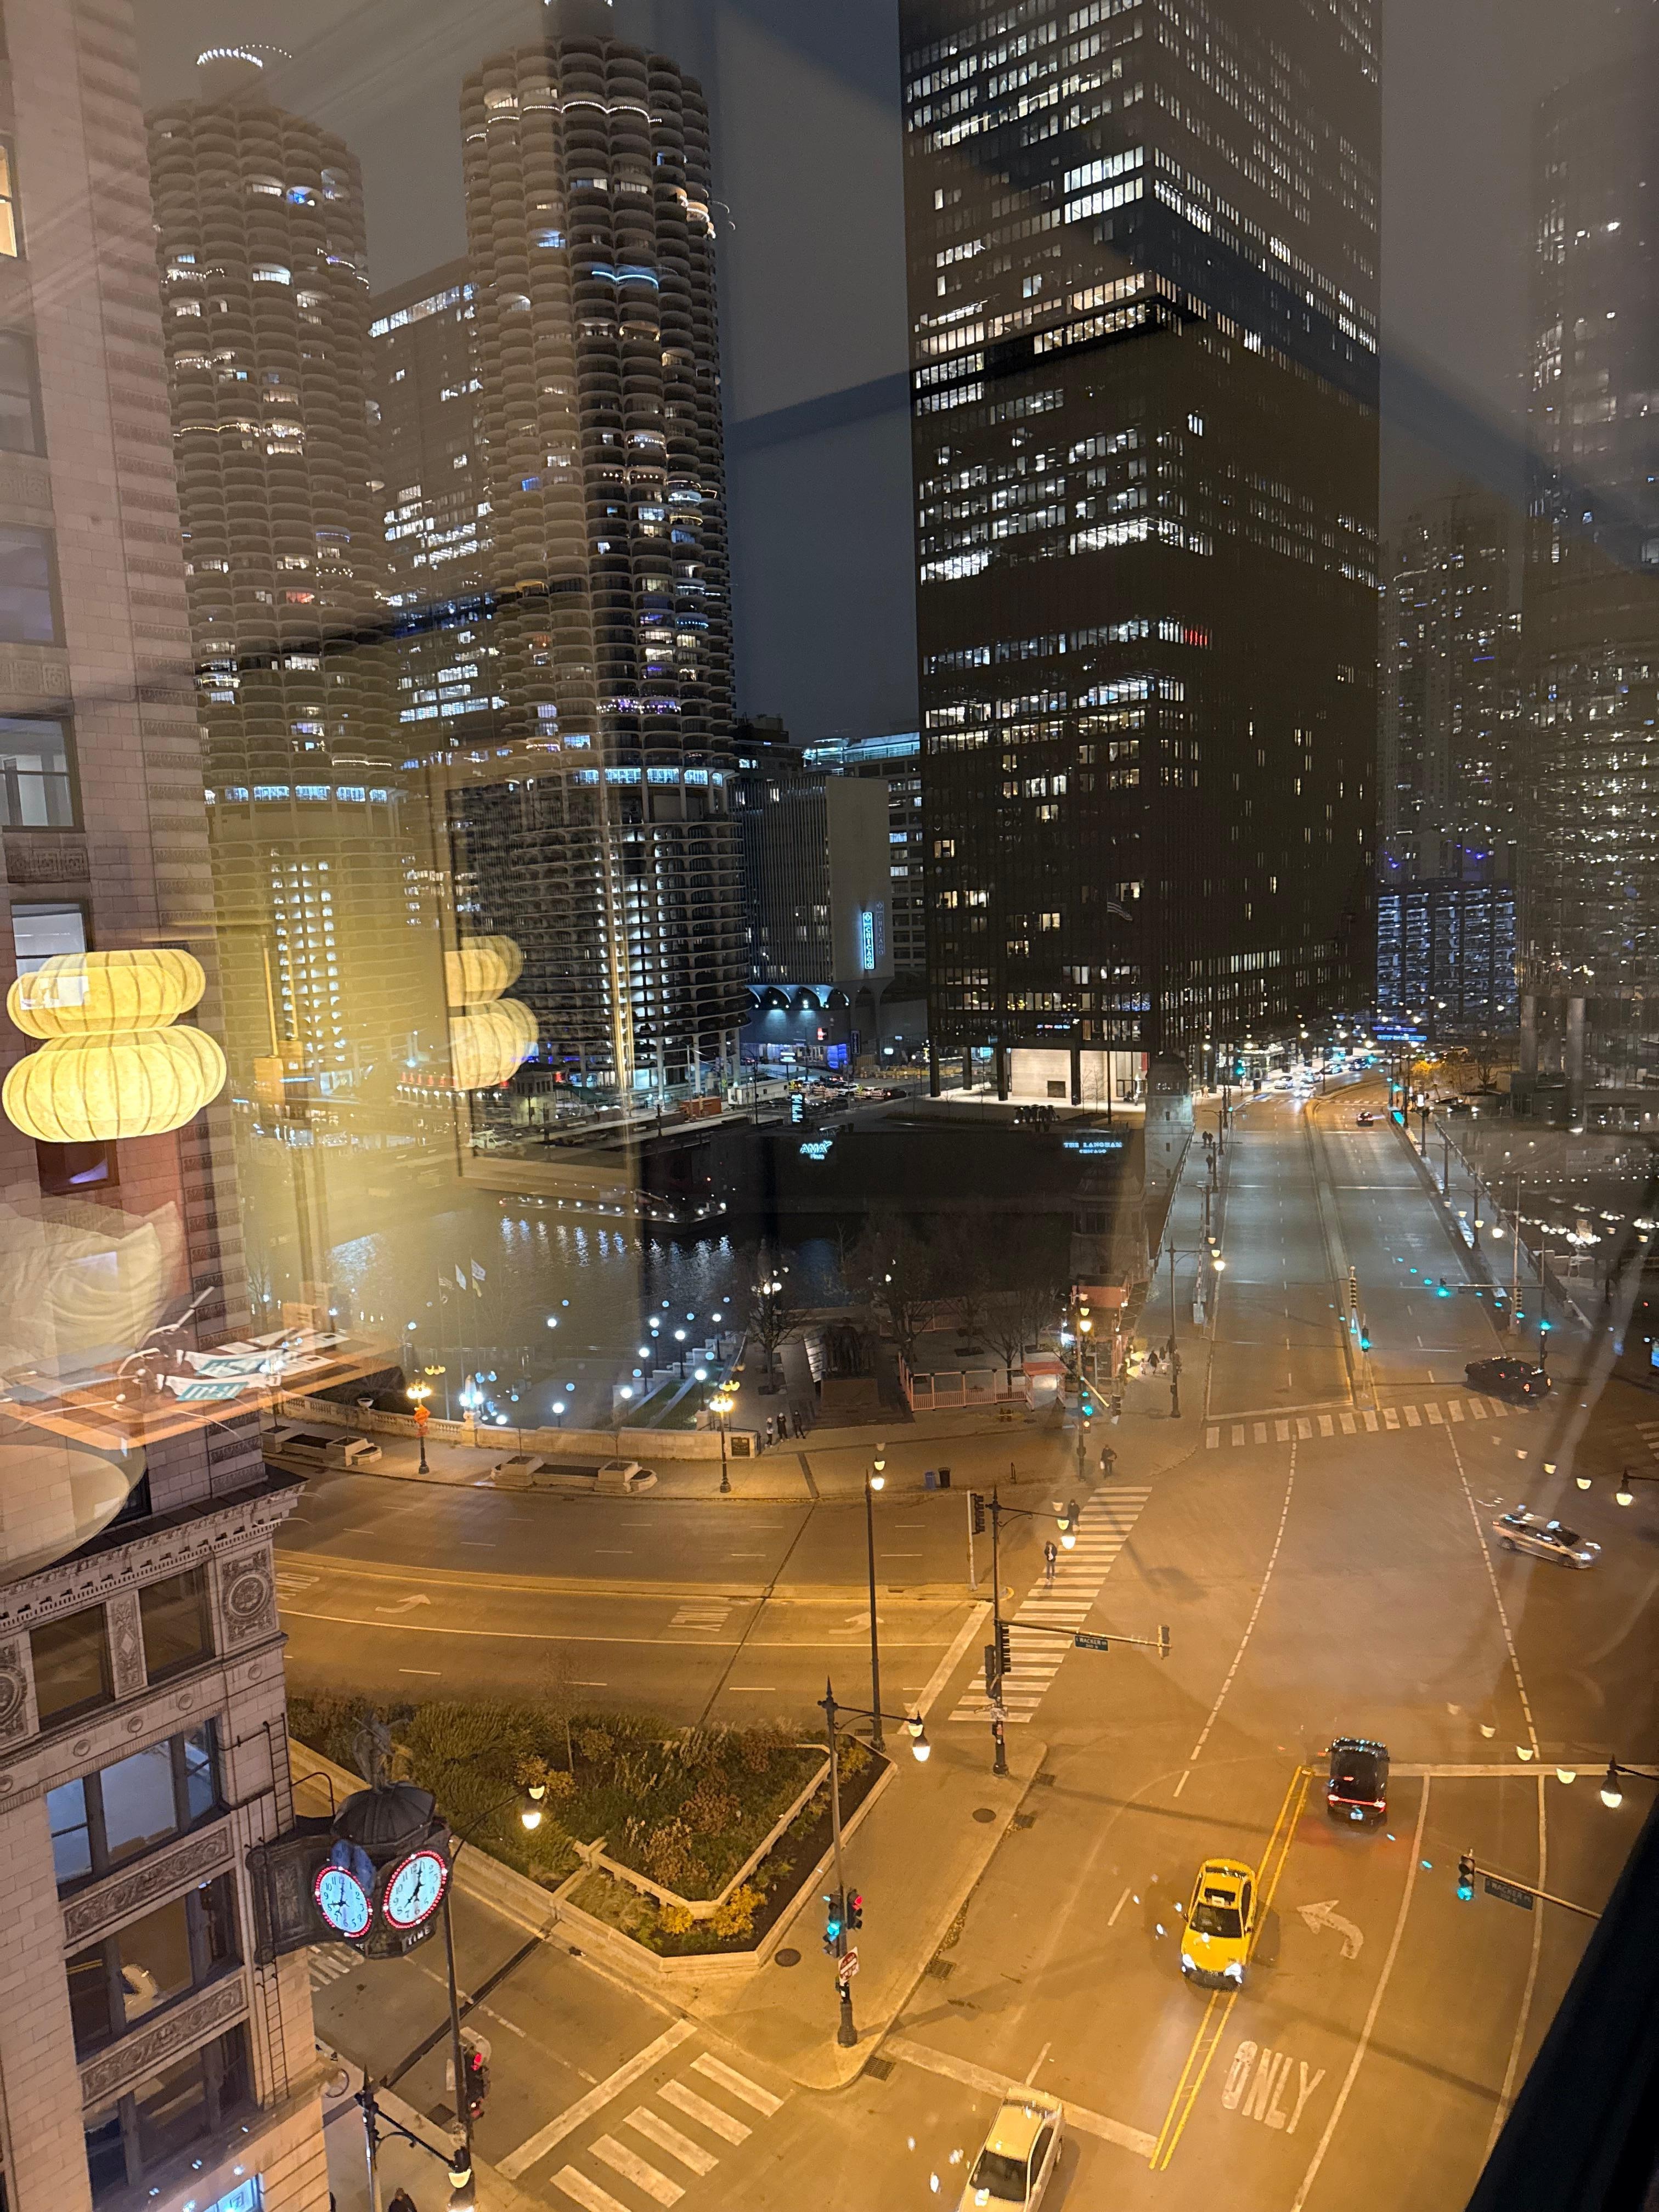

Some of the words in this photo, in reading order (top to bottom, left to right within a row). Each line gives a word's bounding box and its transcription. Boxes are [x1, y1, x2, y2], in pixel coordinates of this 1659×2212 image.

[799, 1143, 827, 1154] AMA
[668, 1605, 733, 1633] ONLY
[331, 1876, 336, 1885] 11
[325, 1883, 332, 1891] 10
[360, 1904, 364, 1912] 3
[343, 1918, 348, 1927] 6
[351, 1918, 357, 1927] 5
[408, 1925, 431, 1945] TIME
[1222, 2040, 1325, 2134] ONLY
